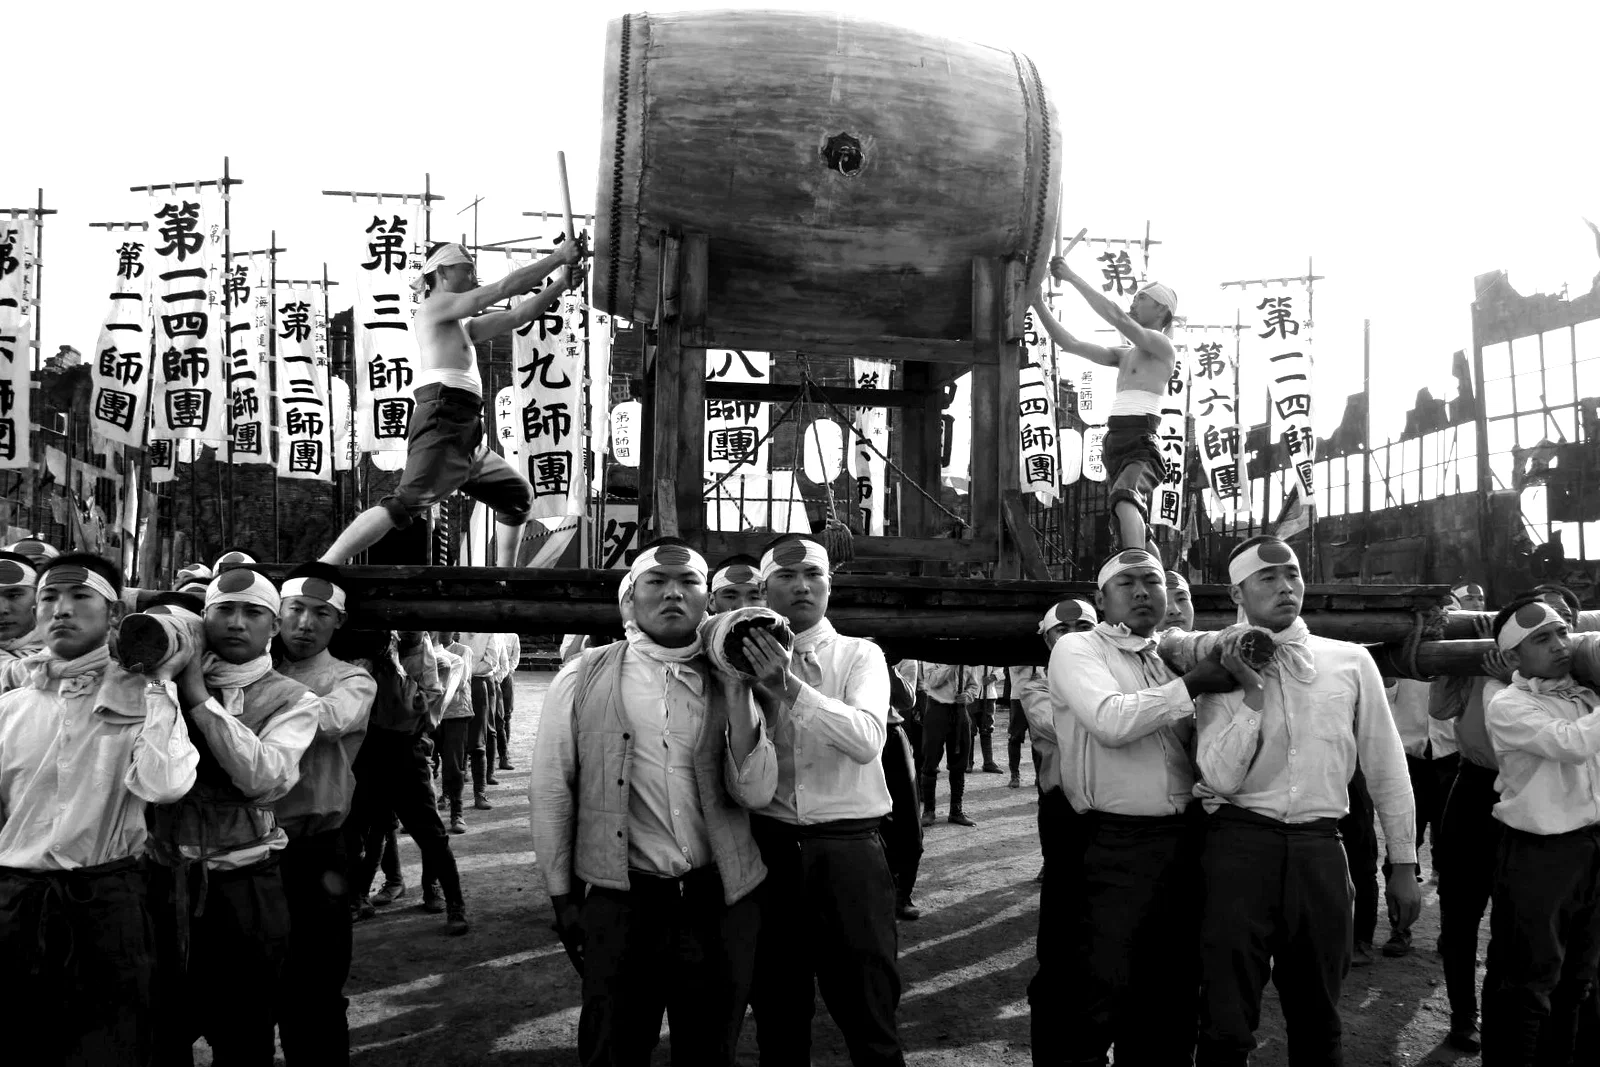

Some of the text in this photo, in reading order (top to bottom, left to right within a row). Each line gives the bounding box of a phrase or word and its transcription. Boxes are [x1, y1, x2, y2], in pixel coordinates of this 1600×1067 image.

[278, 300, 324, 476] 第一三師團
[361, 215, 416, 440] 第三師團
[1194, 341, 1240, 500] 第六師團
